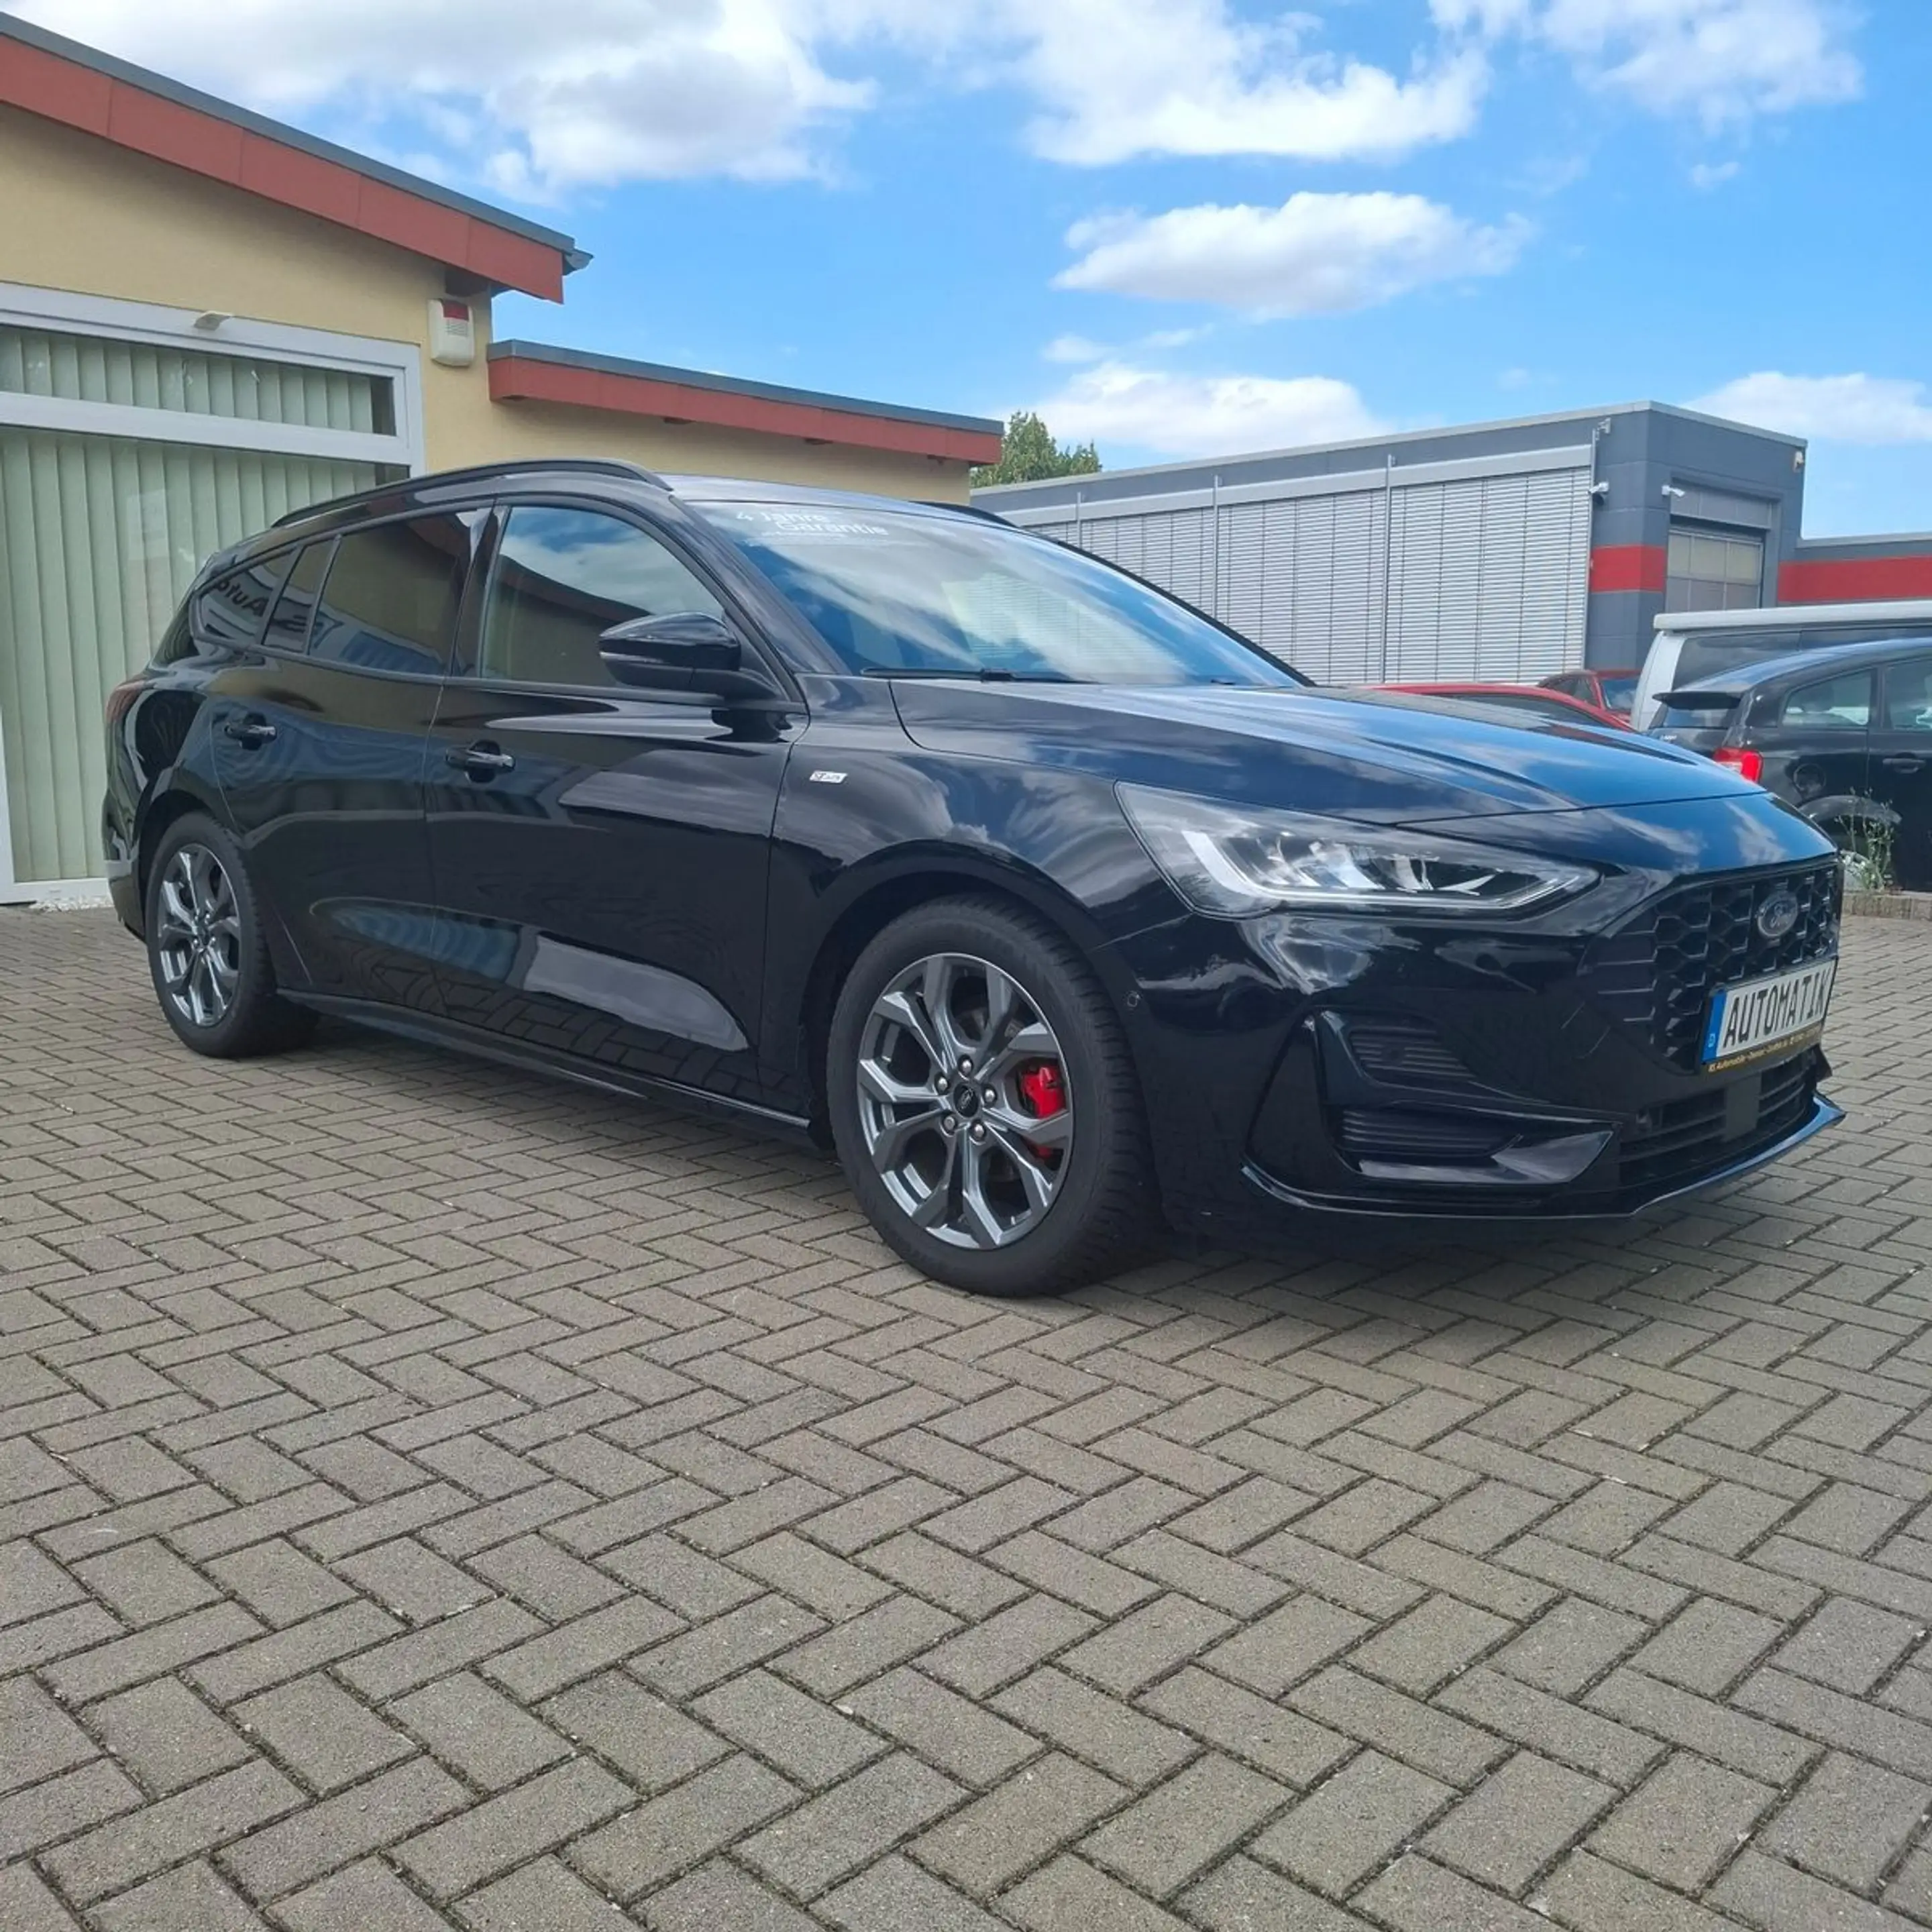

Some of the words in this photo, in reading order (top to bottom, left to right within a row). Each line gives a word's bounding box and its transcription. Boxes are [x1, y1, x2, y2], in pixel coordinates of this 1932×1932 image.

[736, 512, 753, 521] 4
[775, 521, 889, 535] Garantie
[1723, 967, 1831, 1048] AUTOMATIK
